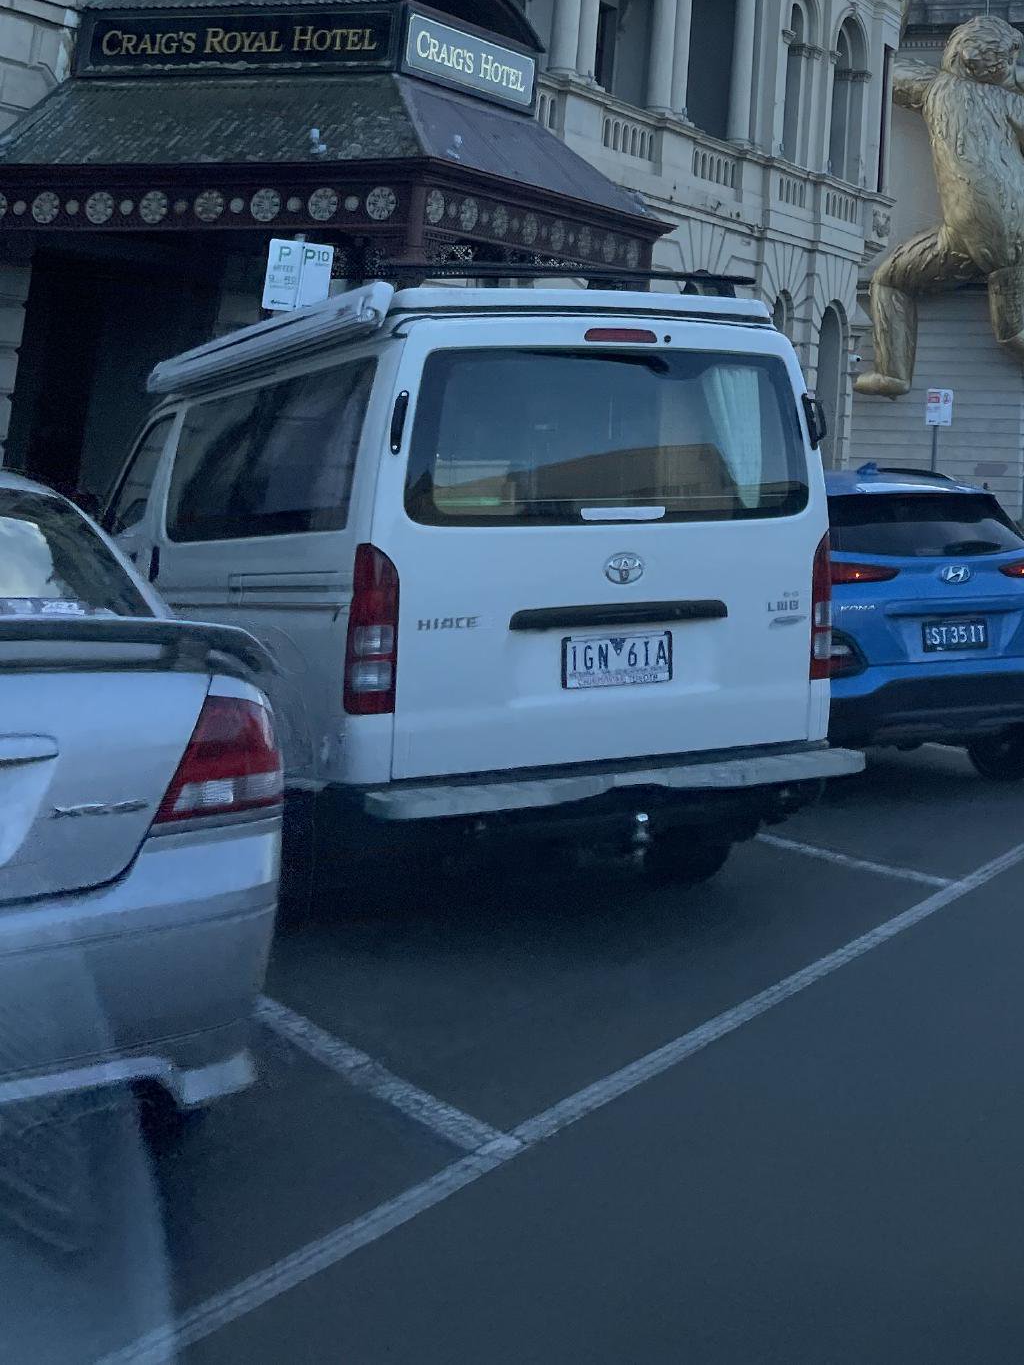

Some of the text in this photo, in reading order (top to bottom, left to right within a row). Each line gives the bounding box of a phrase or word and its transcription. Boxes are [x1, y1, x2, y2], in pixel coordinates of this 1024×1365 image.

[102, 25, 378, 56] CRAIG'S ROYAL HOTEL
[416, 30, 525, 92] CRAIG'S HOTEL
[417, 616, 479, 631] HIACE
